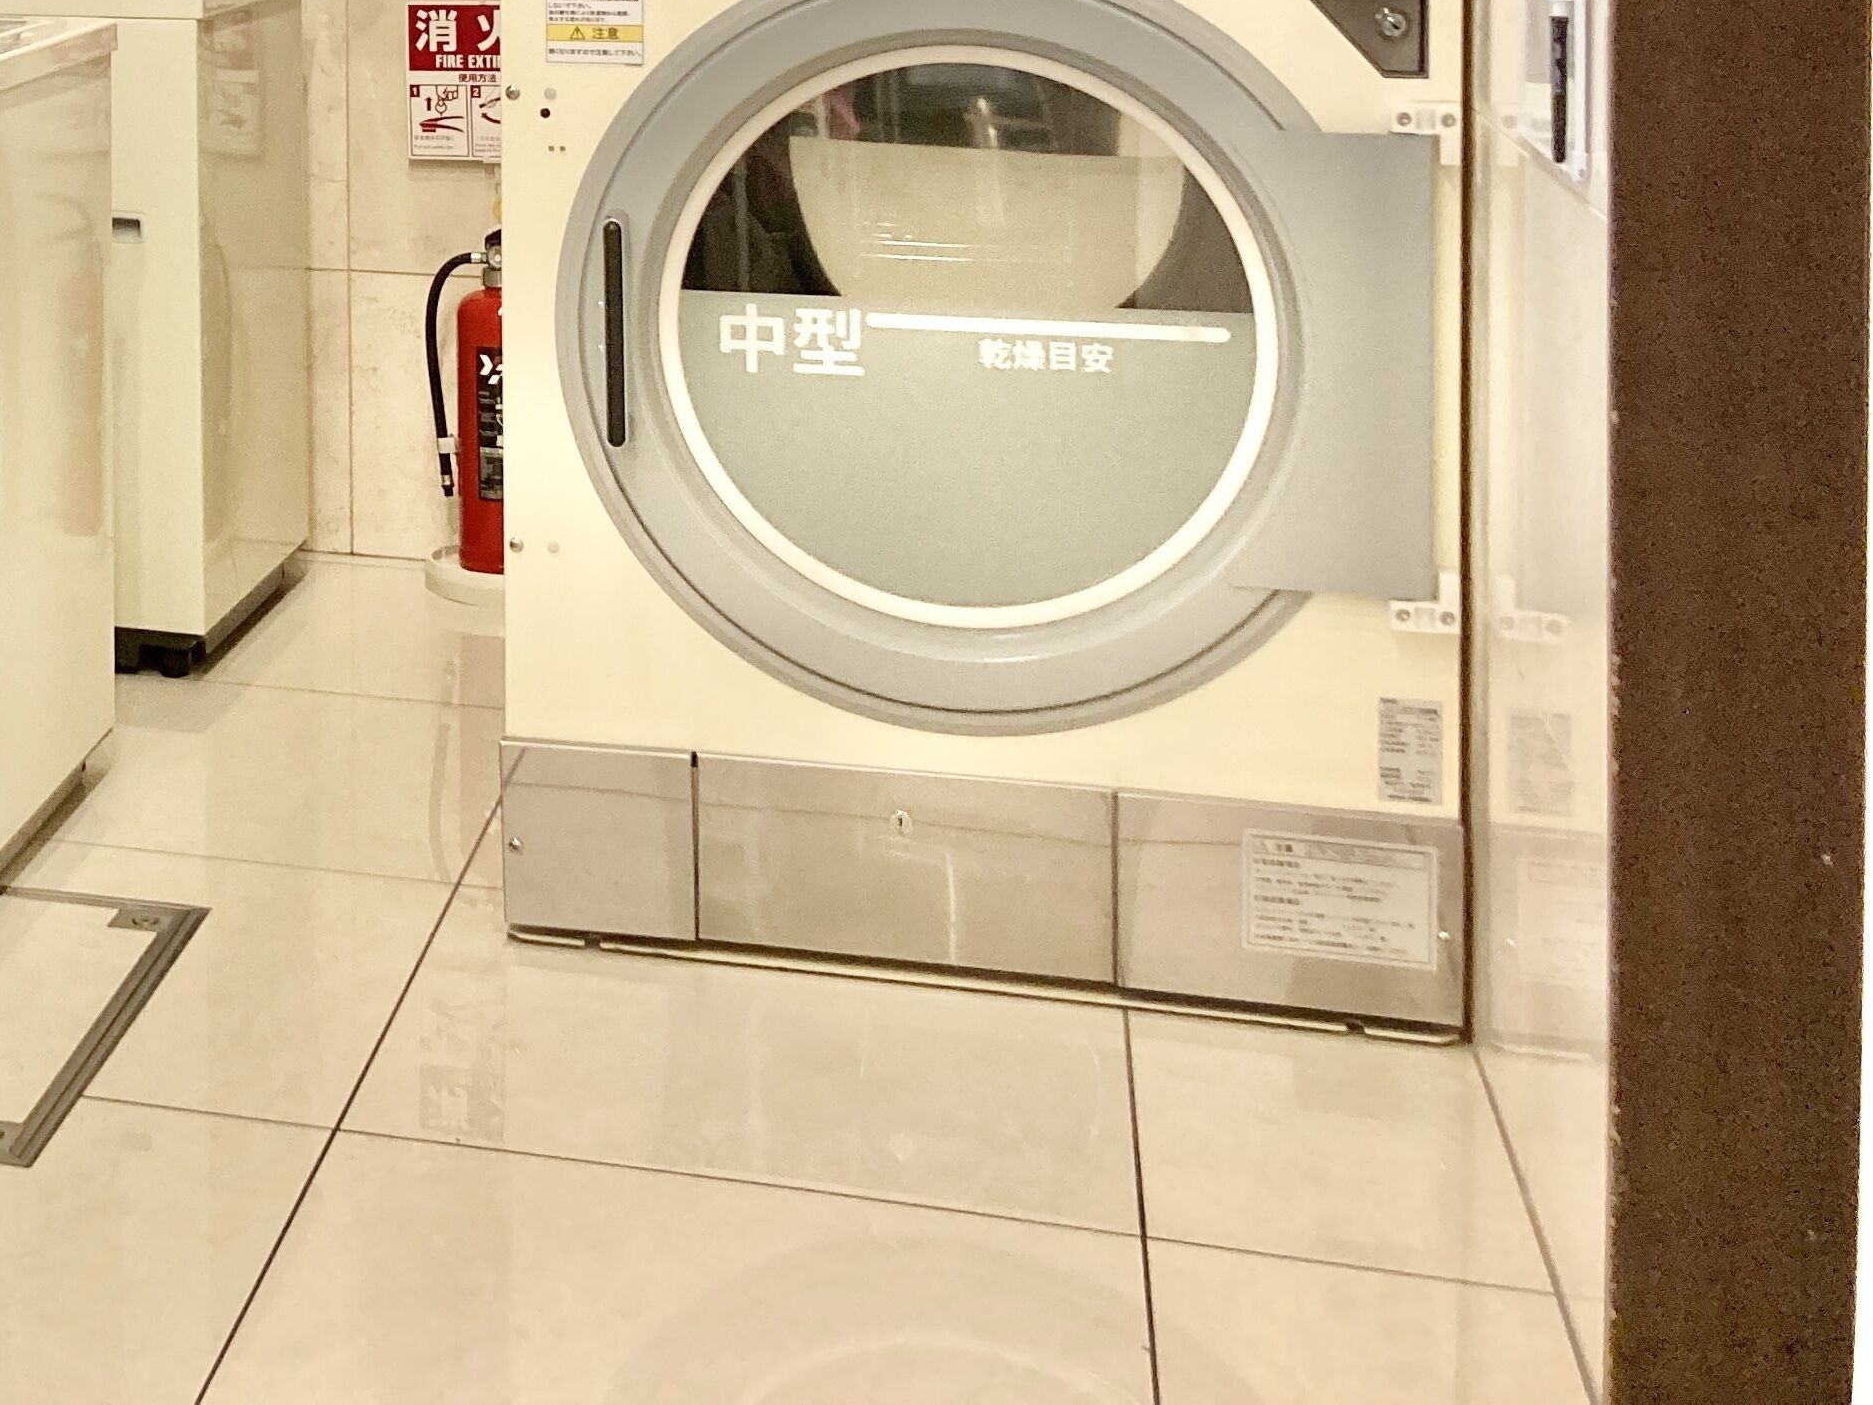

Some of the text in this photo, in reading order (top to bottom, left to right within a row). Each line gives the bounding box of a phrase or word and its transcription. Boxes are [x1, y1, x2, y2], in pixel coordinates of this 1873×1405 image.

[592, 26, 620, 40] 注意
[435, 54, 464, 69] FIRE
[459, 73, 497, 83] 使用方法
[719, 303, 865, 377] 中型
[978, 338, 1114, 374] 乾燥目安
